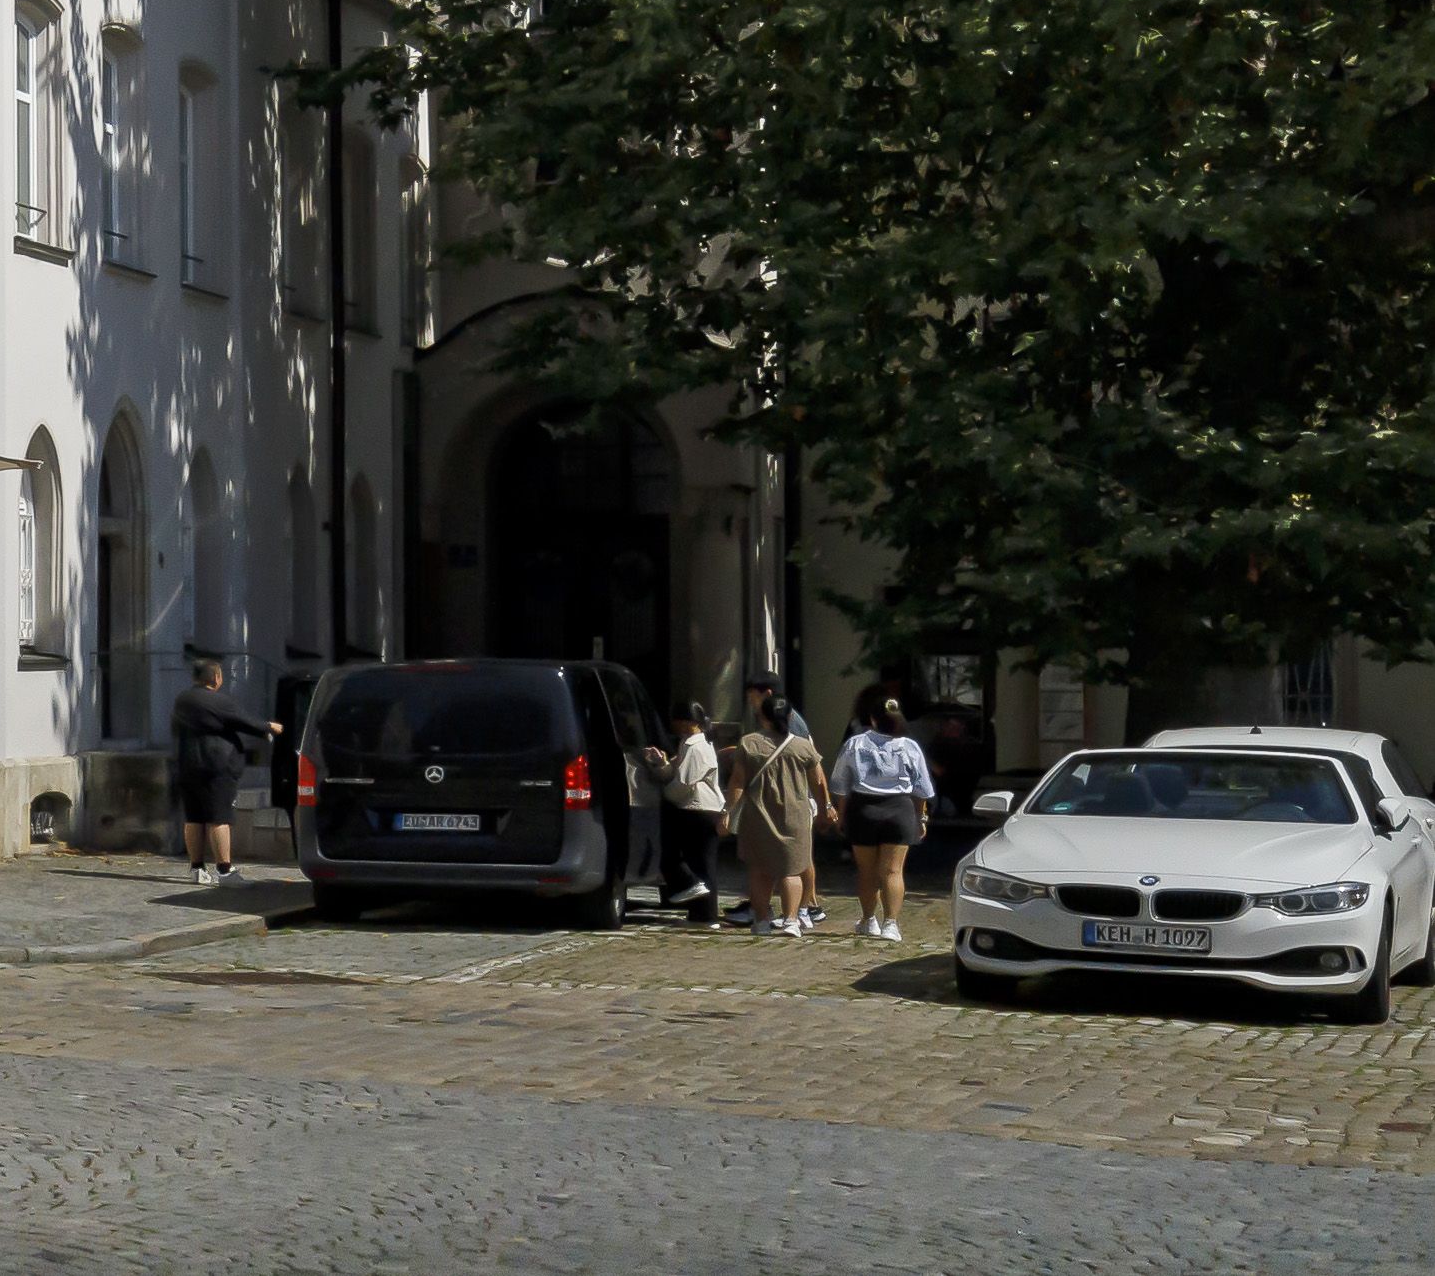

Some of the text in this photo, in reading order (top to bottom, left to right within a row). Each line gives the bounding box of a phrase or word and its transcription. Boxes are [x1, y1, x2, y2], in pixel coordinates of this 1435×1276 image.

[1096, 925, 1207, 947] KEH H 1097
